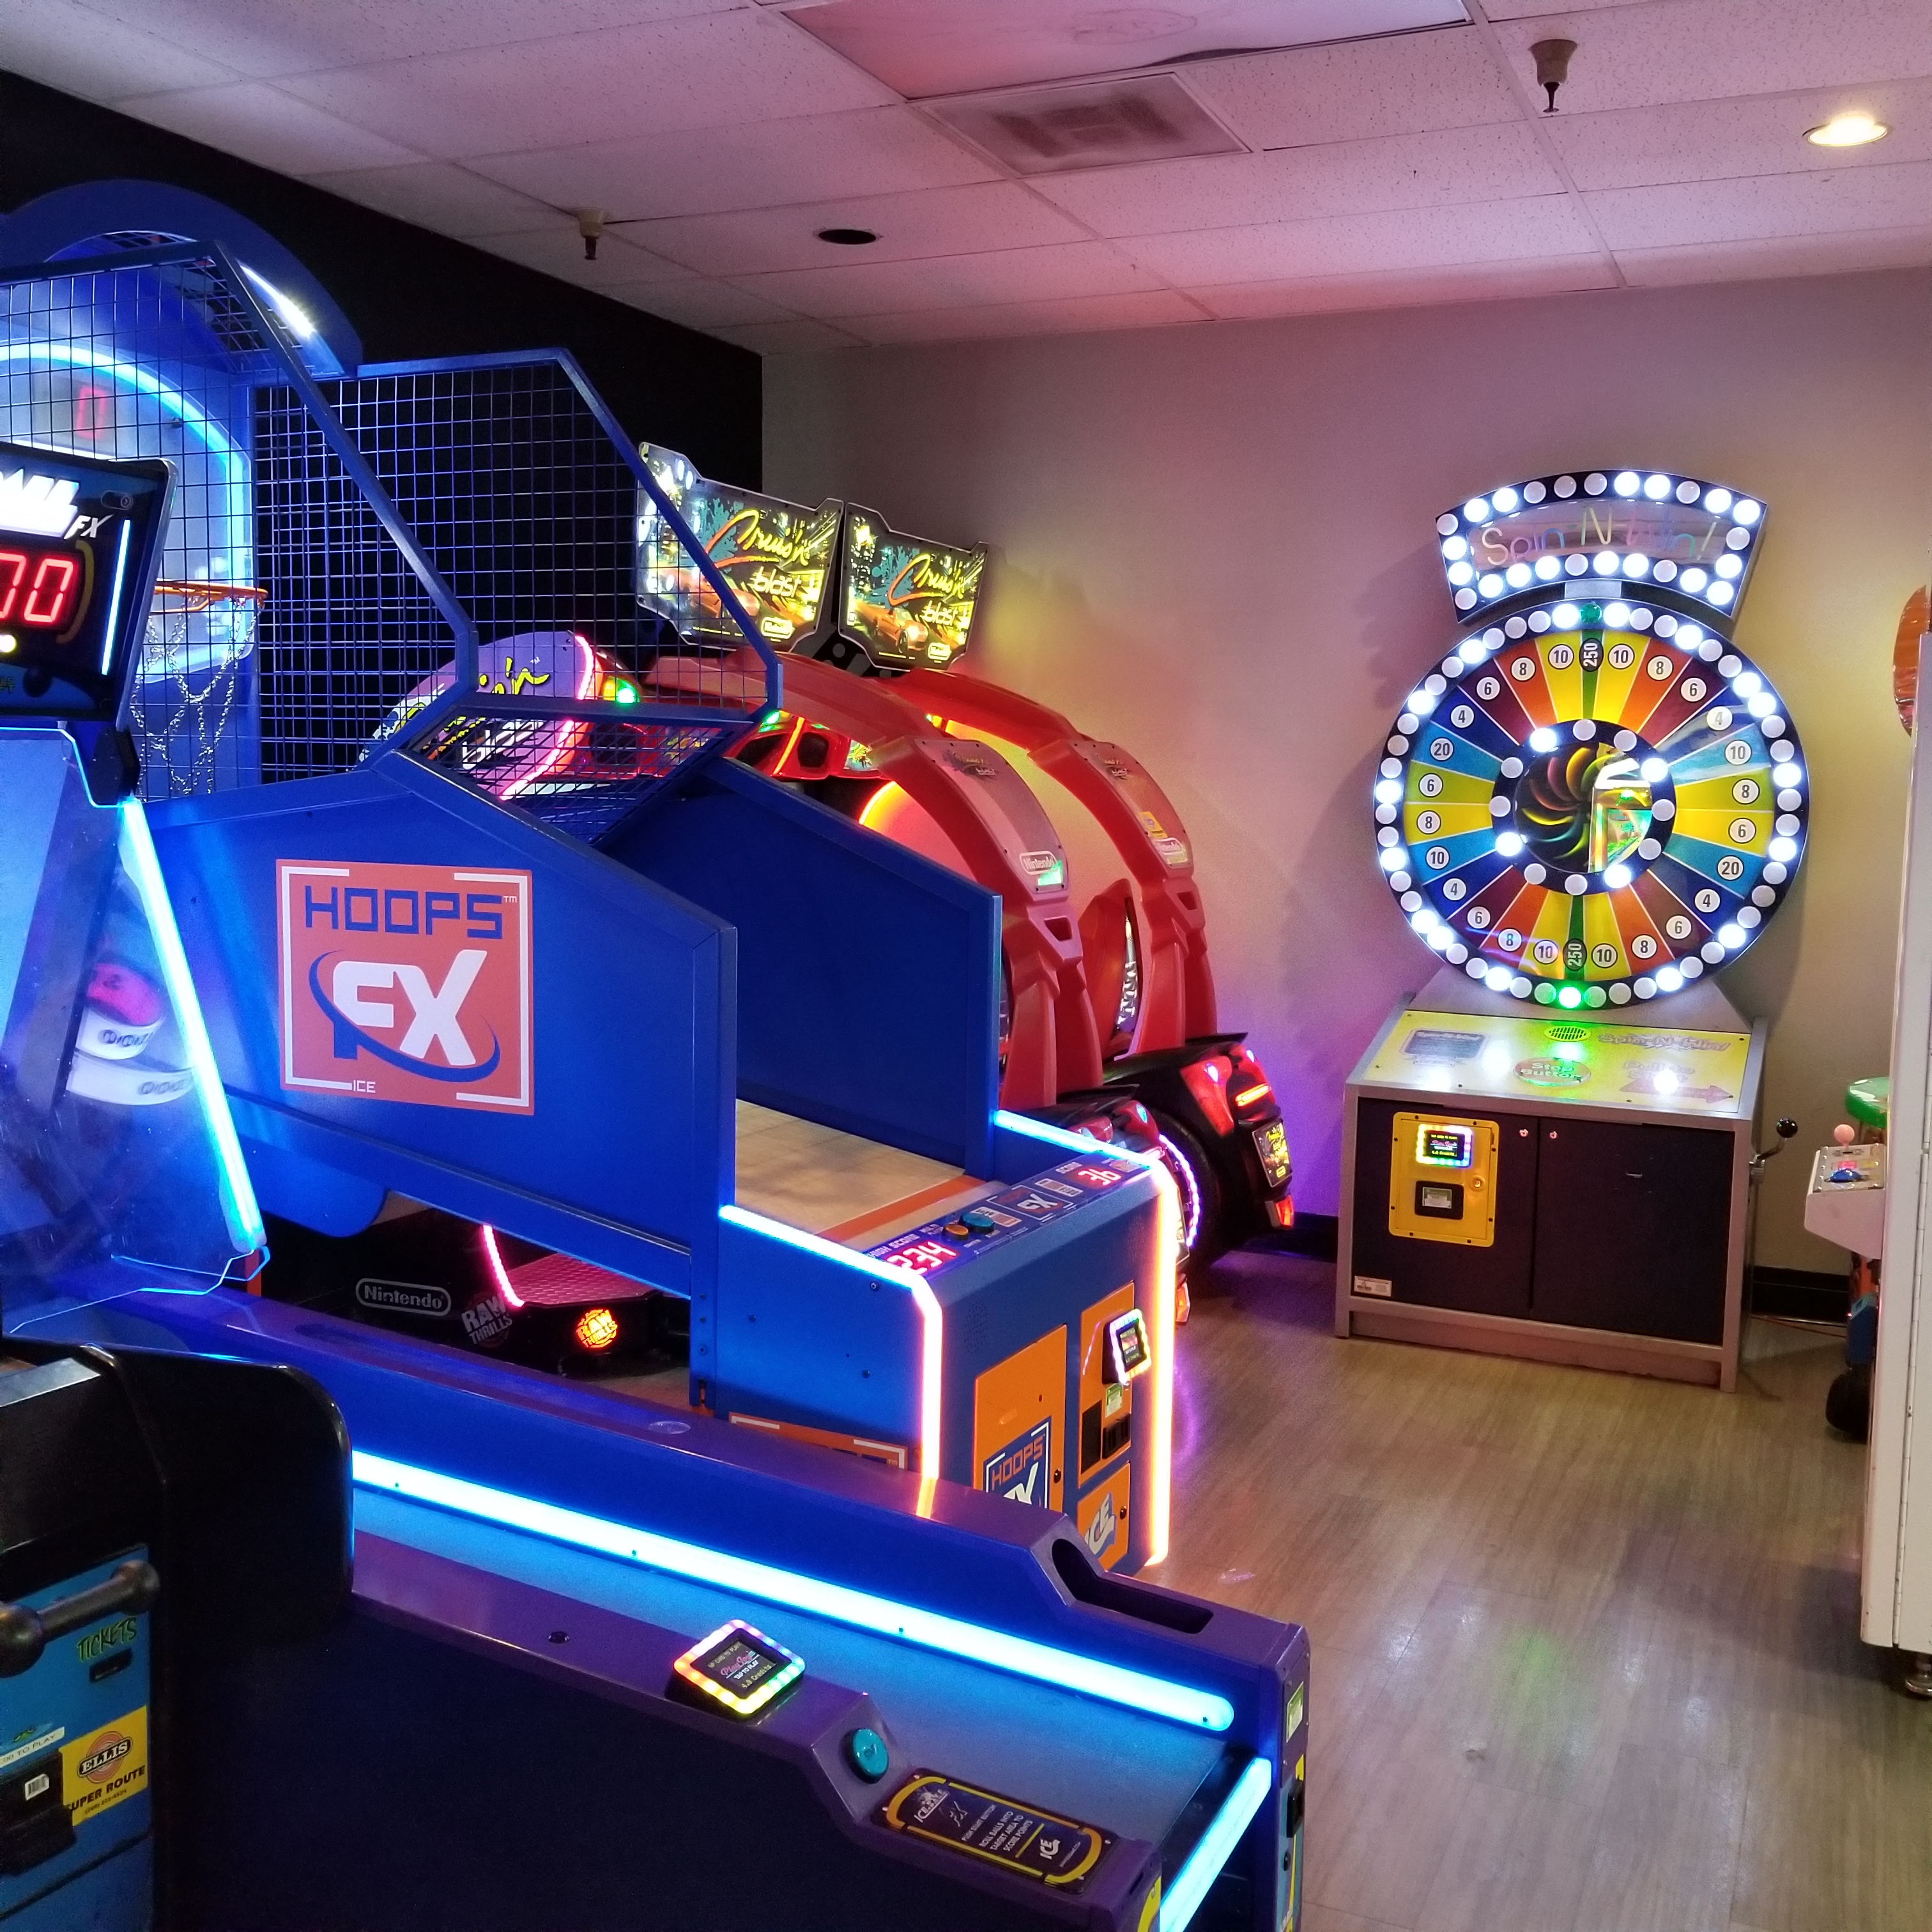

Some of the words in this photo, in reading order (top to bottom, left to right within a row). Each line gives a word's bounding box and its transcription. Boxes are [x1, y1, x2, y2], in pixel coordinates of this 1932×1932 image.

[64, 514, 114, 539] FX
[749, 566, 802, 597] blast
[888, 553, 965, 606] Cruis'n
[1553, 650, 1568, 664] 10
[1583, 643, 1598, 667] 250
[1613, 650, 1629, 664] 10
[1519, 662, 1527, 676] 8
[1655, 661, 1664, 675] 8
[1484, 682, 1492, 696] 6
[1689, 682, 1698, 697] 6
[1458, 710, 1466, 723] 4
[1714, 711, 1724, 726] 4
[1434, 742, 1450, 756] 20
[1729, 746, 1746, 760] 10
[1427, 779, 1435, 792] 6
[1741, 784, 1750, 799] 8
[1425, 816, 1432, 829] 8
[1738, 824, 1747, 838] 6
[1430, 851, 1445, 864] 10
[1721, 861, 1740, 875] 20
[1450, 882, 1458, 896] 4
[1702, 894, 1711, 908] 4
[305, 885, 503, 939] HOOPS
[1475, 911, 1483, 924] 6
[1674, 921, 1683, 935] 6
[1506, 933, 1514, 947] 8
[1640, 940, 1648, 954] 8
[1538, 945, 1553, 959] 10
[1567, 943, 1583, 967] 250
[1597, 949, 1612, 963] 10
[1521, 1068, 1582, 1080] Button
[1531, 1062, 1575, 1073] Stop
[353, 1080, 376, 1093] ICE
[889, 1234, 920, 1248] SCORE
[887, 1241, 956, 1274] 234
[364, 1285, 442, 1309] Nintendo
[461, 1296, 506, 1333] RAW
[469, 1313, 512, 1345] THRILLS
[992, 1436, 1043, 1491] HOOPS
[77, 1617, 137, 1662] TICKETS
[17, 1747, 30, 1756] TO
[32, 1733, 56, 1749] PLAY
[81, 1741, 128, 1774] ELLIS
[106, 1765, 145, 1794] ROUTE
[1039, 1839, 1061, 1860] ICE
